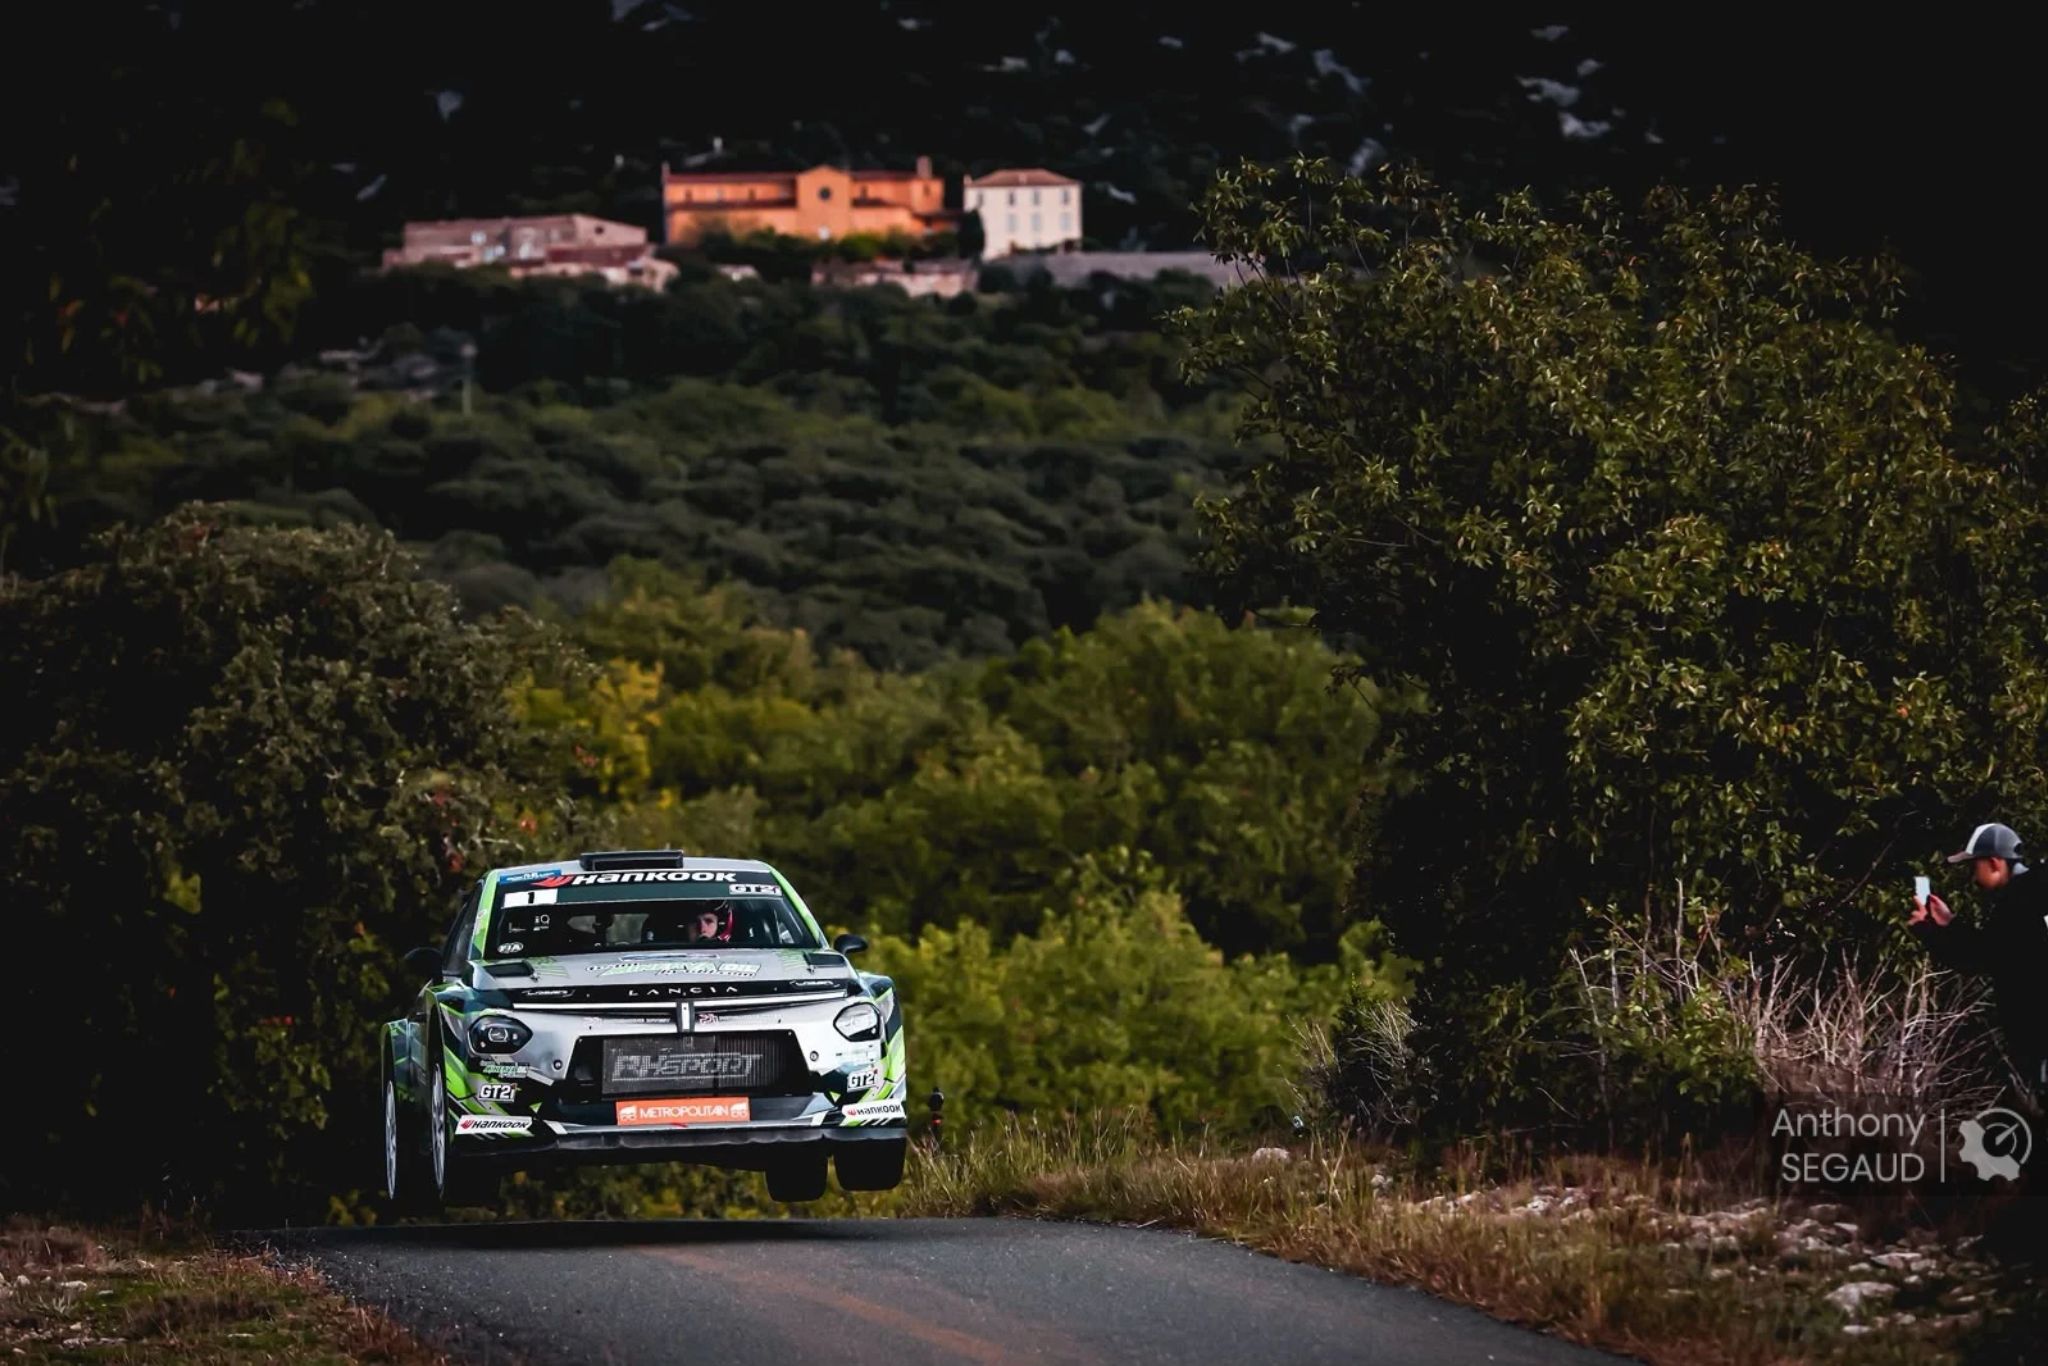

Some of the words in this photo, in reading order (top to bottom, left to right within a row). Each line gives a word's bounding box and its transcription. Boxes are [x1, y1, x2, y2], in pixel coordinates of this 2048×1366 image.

[527, 892, 535, 904] 1
[628, 986, 738, 997] LANCIA
[640, 1104, 729, 1119] METROPOLITAN
